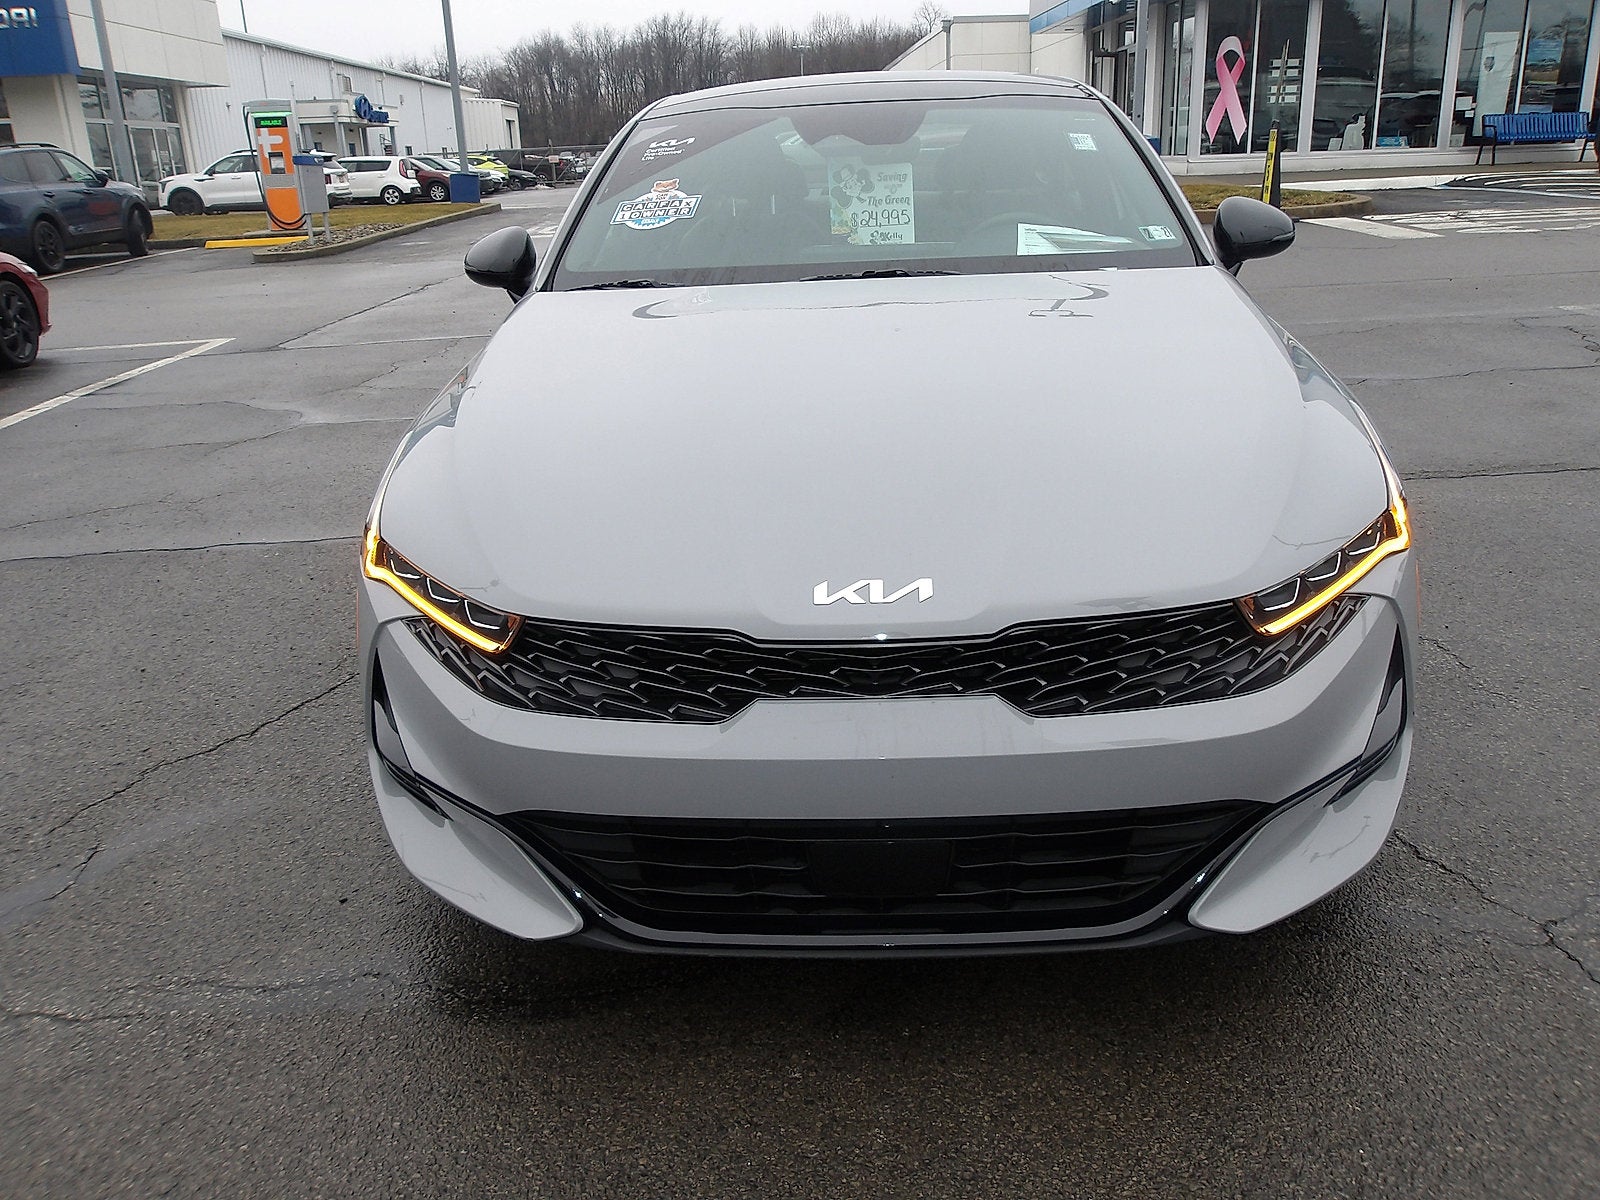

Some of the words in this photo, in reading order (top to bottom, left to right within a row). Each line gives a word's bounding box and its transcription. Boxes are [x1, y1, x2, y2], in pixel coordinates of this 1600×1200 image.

[649, 137, 695, 148] KIA
[877, 172, 908, 184] Saving
[622, 200, 693, 212] CARFAX
[867, 196, 883, 208] The
[885, 195, 911, 206] Green
[630, 207, 692, 219] OWNER
[813, 577, 934, 605] KIA
